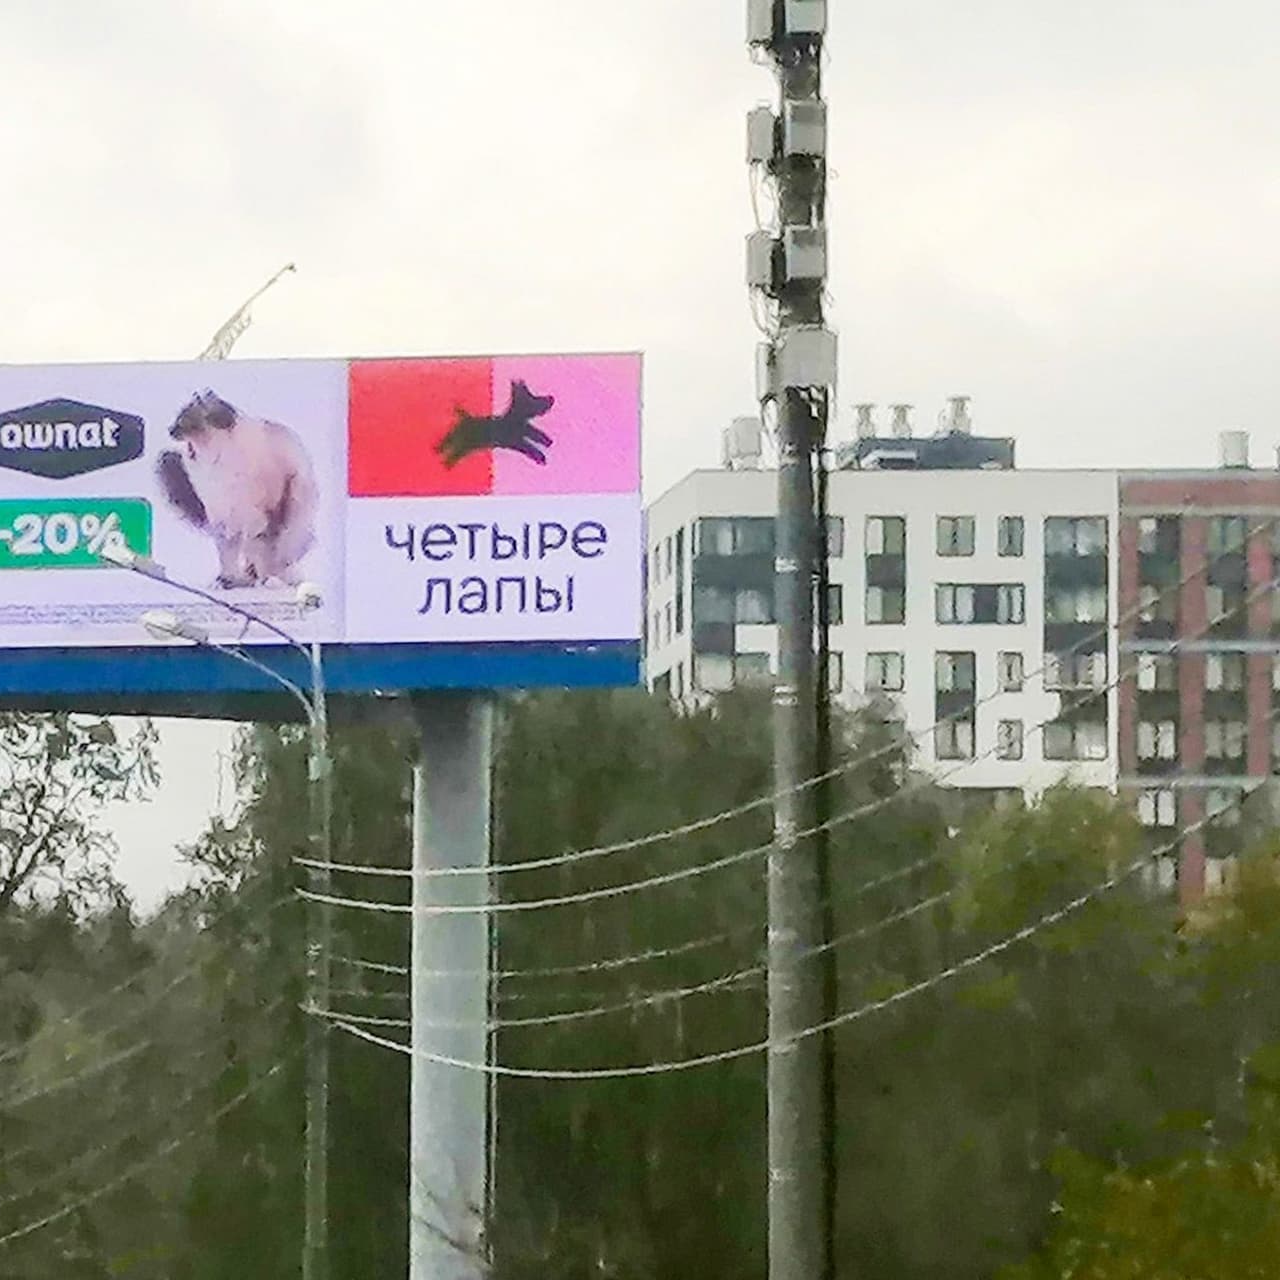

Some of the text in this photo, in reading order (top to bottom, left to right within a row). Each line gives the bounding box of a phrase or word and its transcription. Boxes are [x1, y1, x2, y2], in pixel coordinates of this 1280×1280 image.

[0, 416, 121, 449] ownat
[384, 520, 609, 561] четыре
[417, 574, 574, 615] лапы
